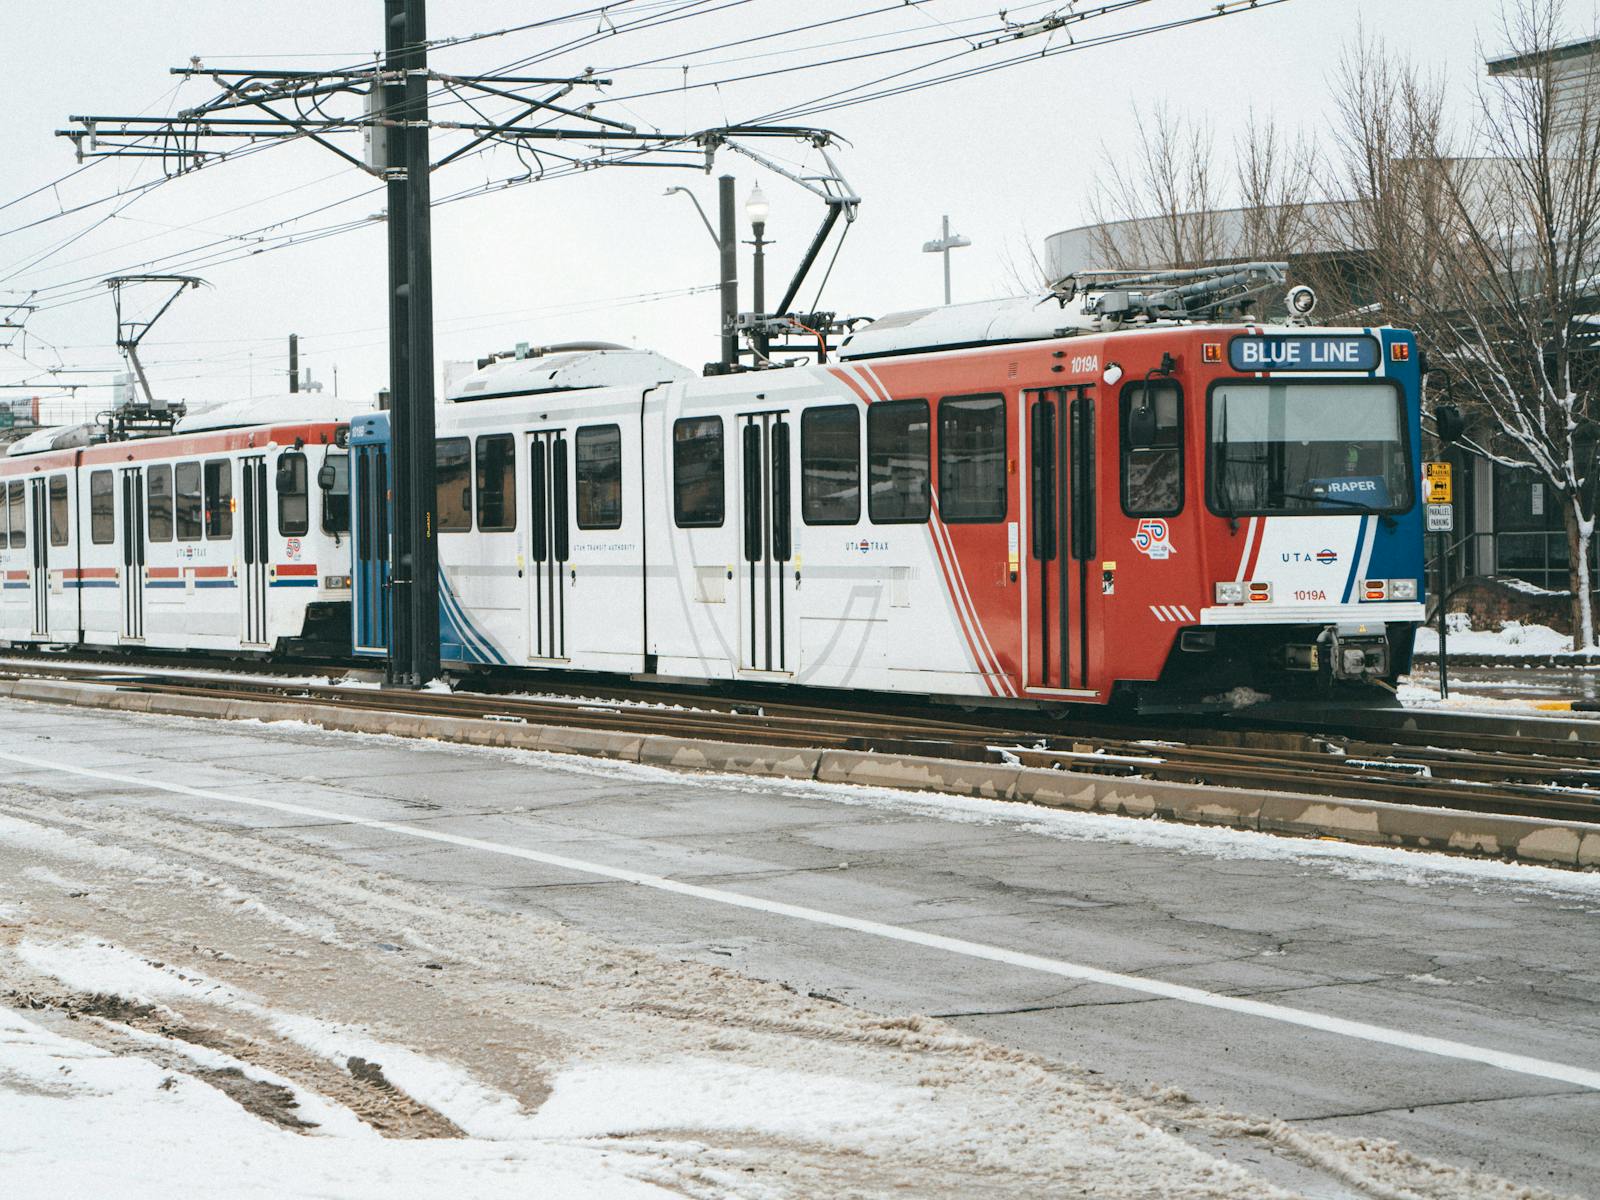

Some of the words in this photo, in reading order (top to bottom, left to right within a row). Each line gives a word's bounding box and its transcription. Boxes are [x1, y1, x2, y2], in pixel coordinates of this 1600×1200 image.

[1242, 342, 1300, 363] BLUE
[1311, 342, 1360, 363] LINE
[1071, 355, 1098, 373] 1019A
[845, 541, 859, 551] UTA
[870, 541, 889, 551] TRAX
[1282, 553, 1312, 562] UTA
[1294, 590, 1326, 601] 1019A
